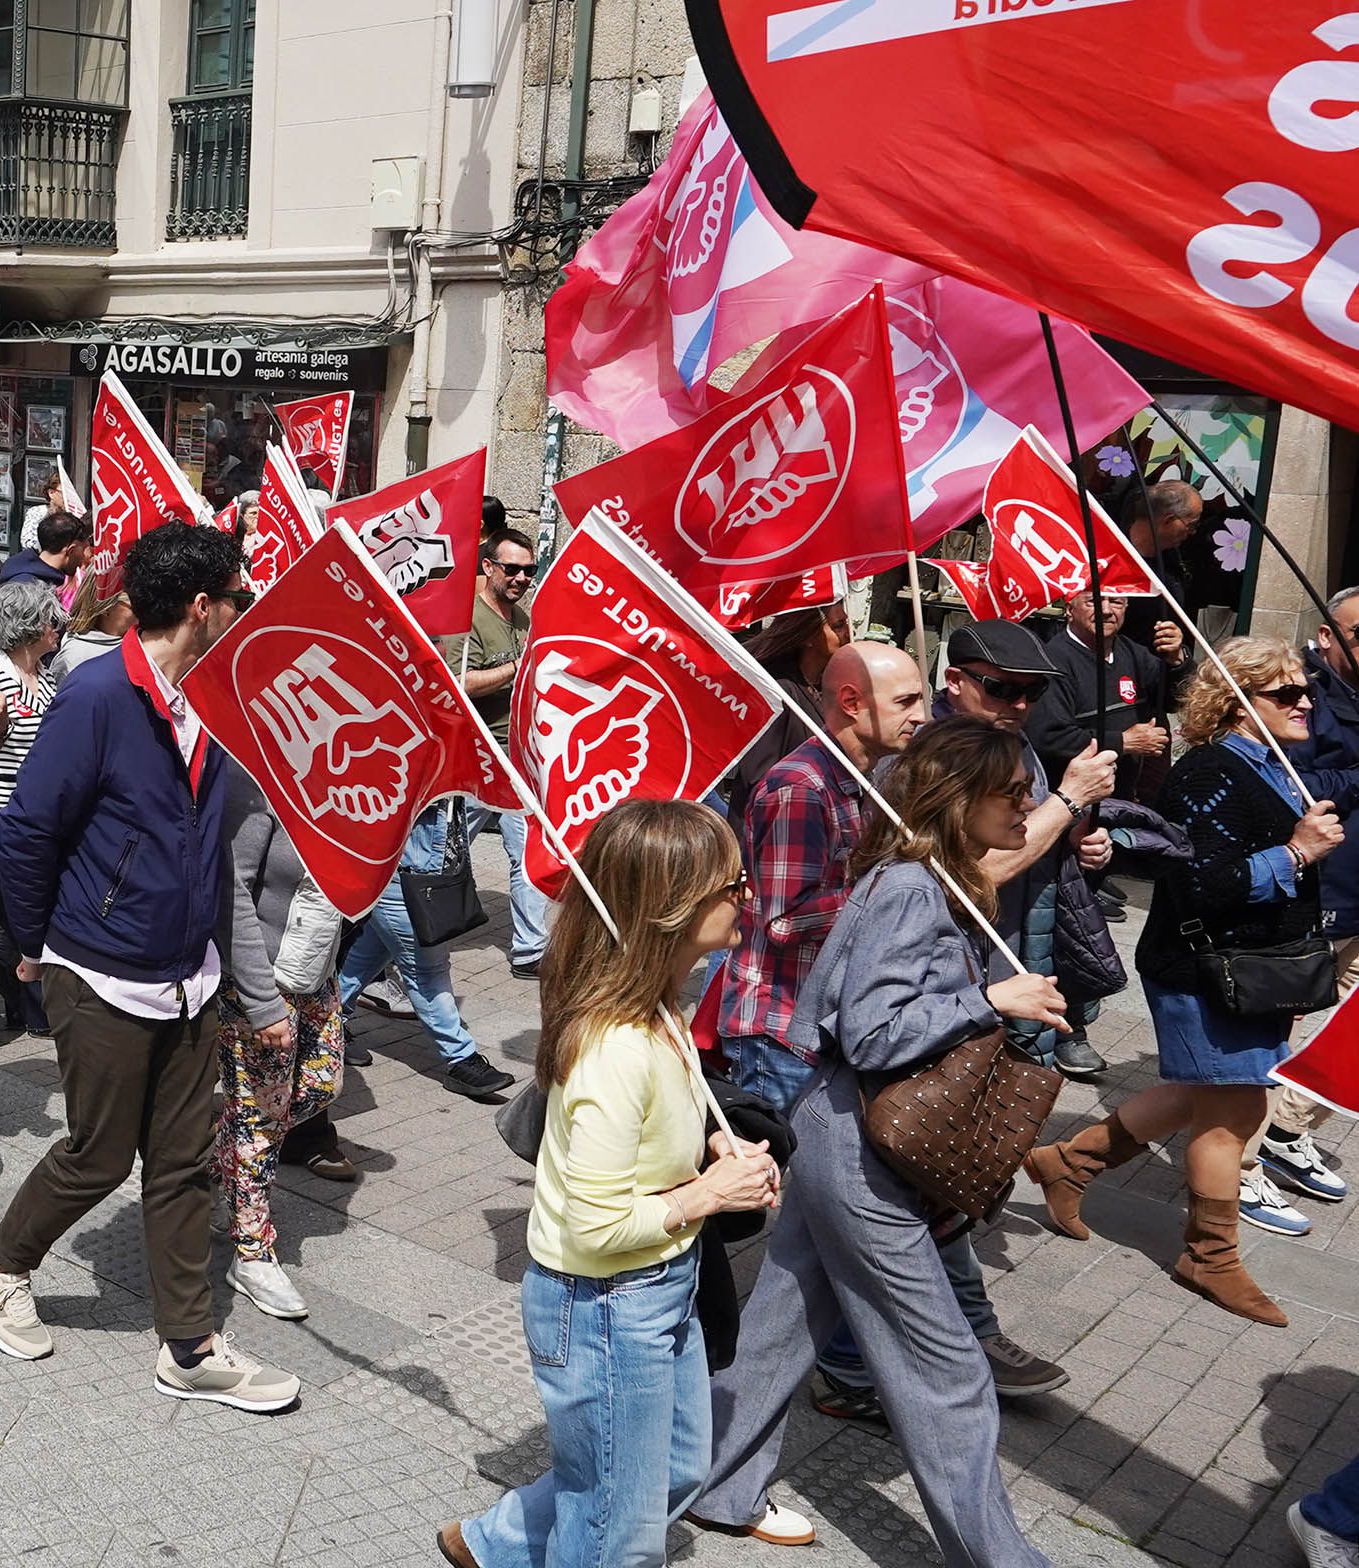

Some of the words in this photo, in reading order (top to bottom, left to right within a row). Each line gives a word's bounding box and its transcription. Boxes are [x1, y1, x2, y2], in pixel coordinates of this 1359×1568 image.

[104, 344, 243, 378] AGASALLO
[254, 367, 285, 380] regalo
[299, 369, 349, 382] souvenirs
[310, 351, 349, 369] galega
[566, 562, 749, 721] www.UGT.es
[248, 642, 377, 776] UGT
